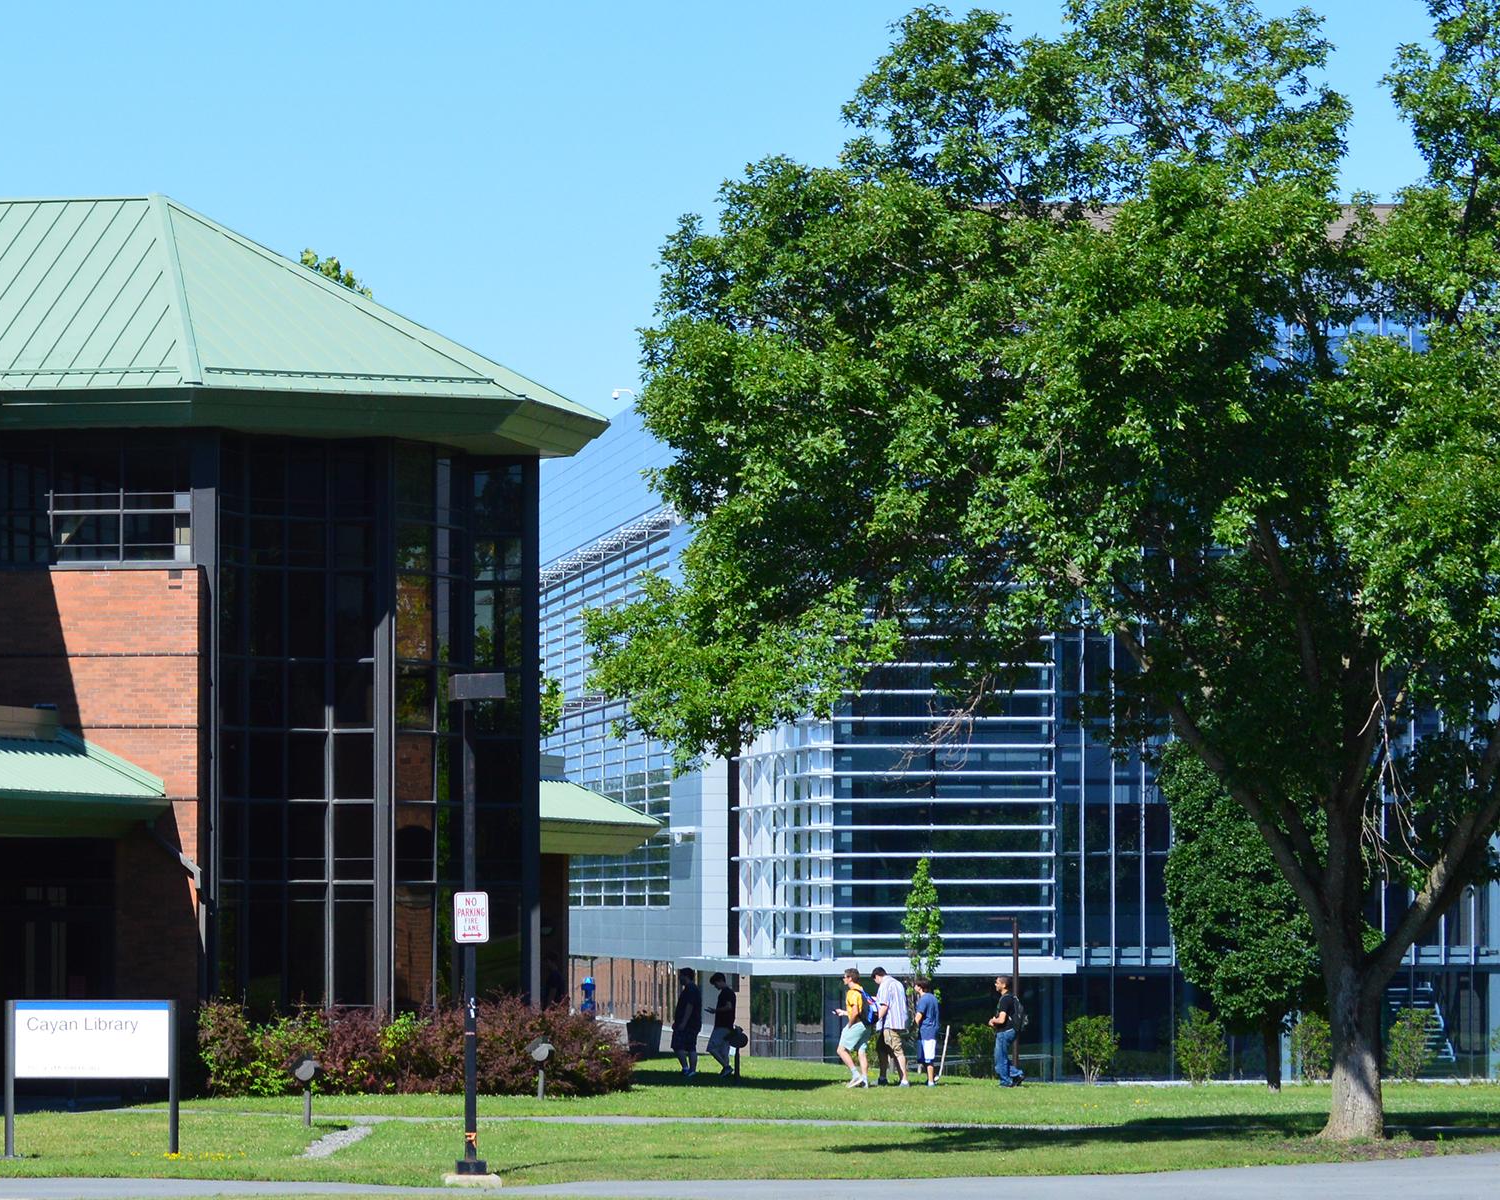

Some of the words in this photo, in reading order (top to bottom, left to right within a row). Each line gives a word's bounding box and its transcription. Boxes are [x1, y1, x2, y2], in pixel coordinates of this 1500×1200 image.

[465, 897, 477, 906] NO
[457, 908, 485, 917] PARKING
[26, 1017, 78, 1034] Cayan
[84, 1016, 139, 1034] Library
